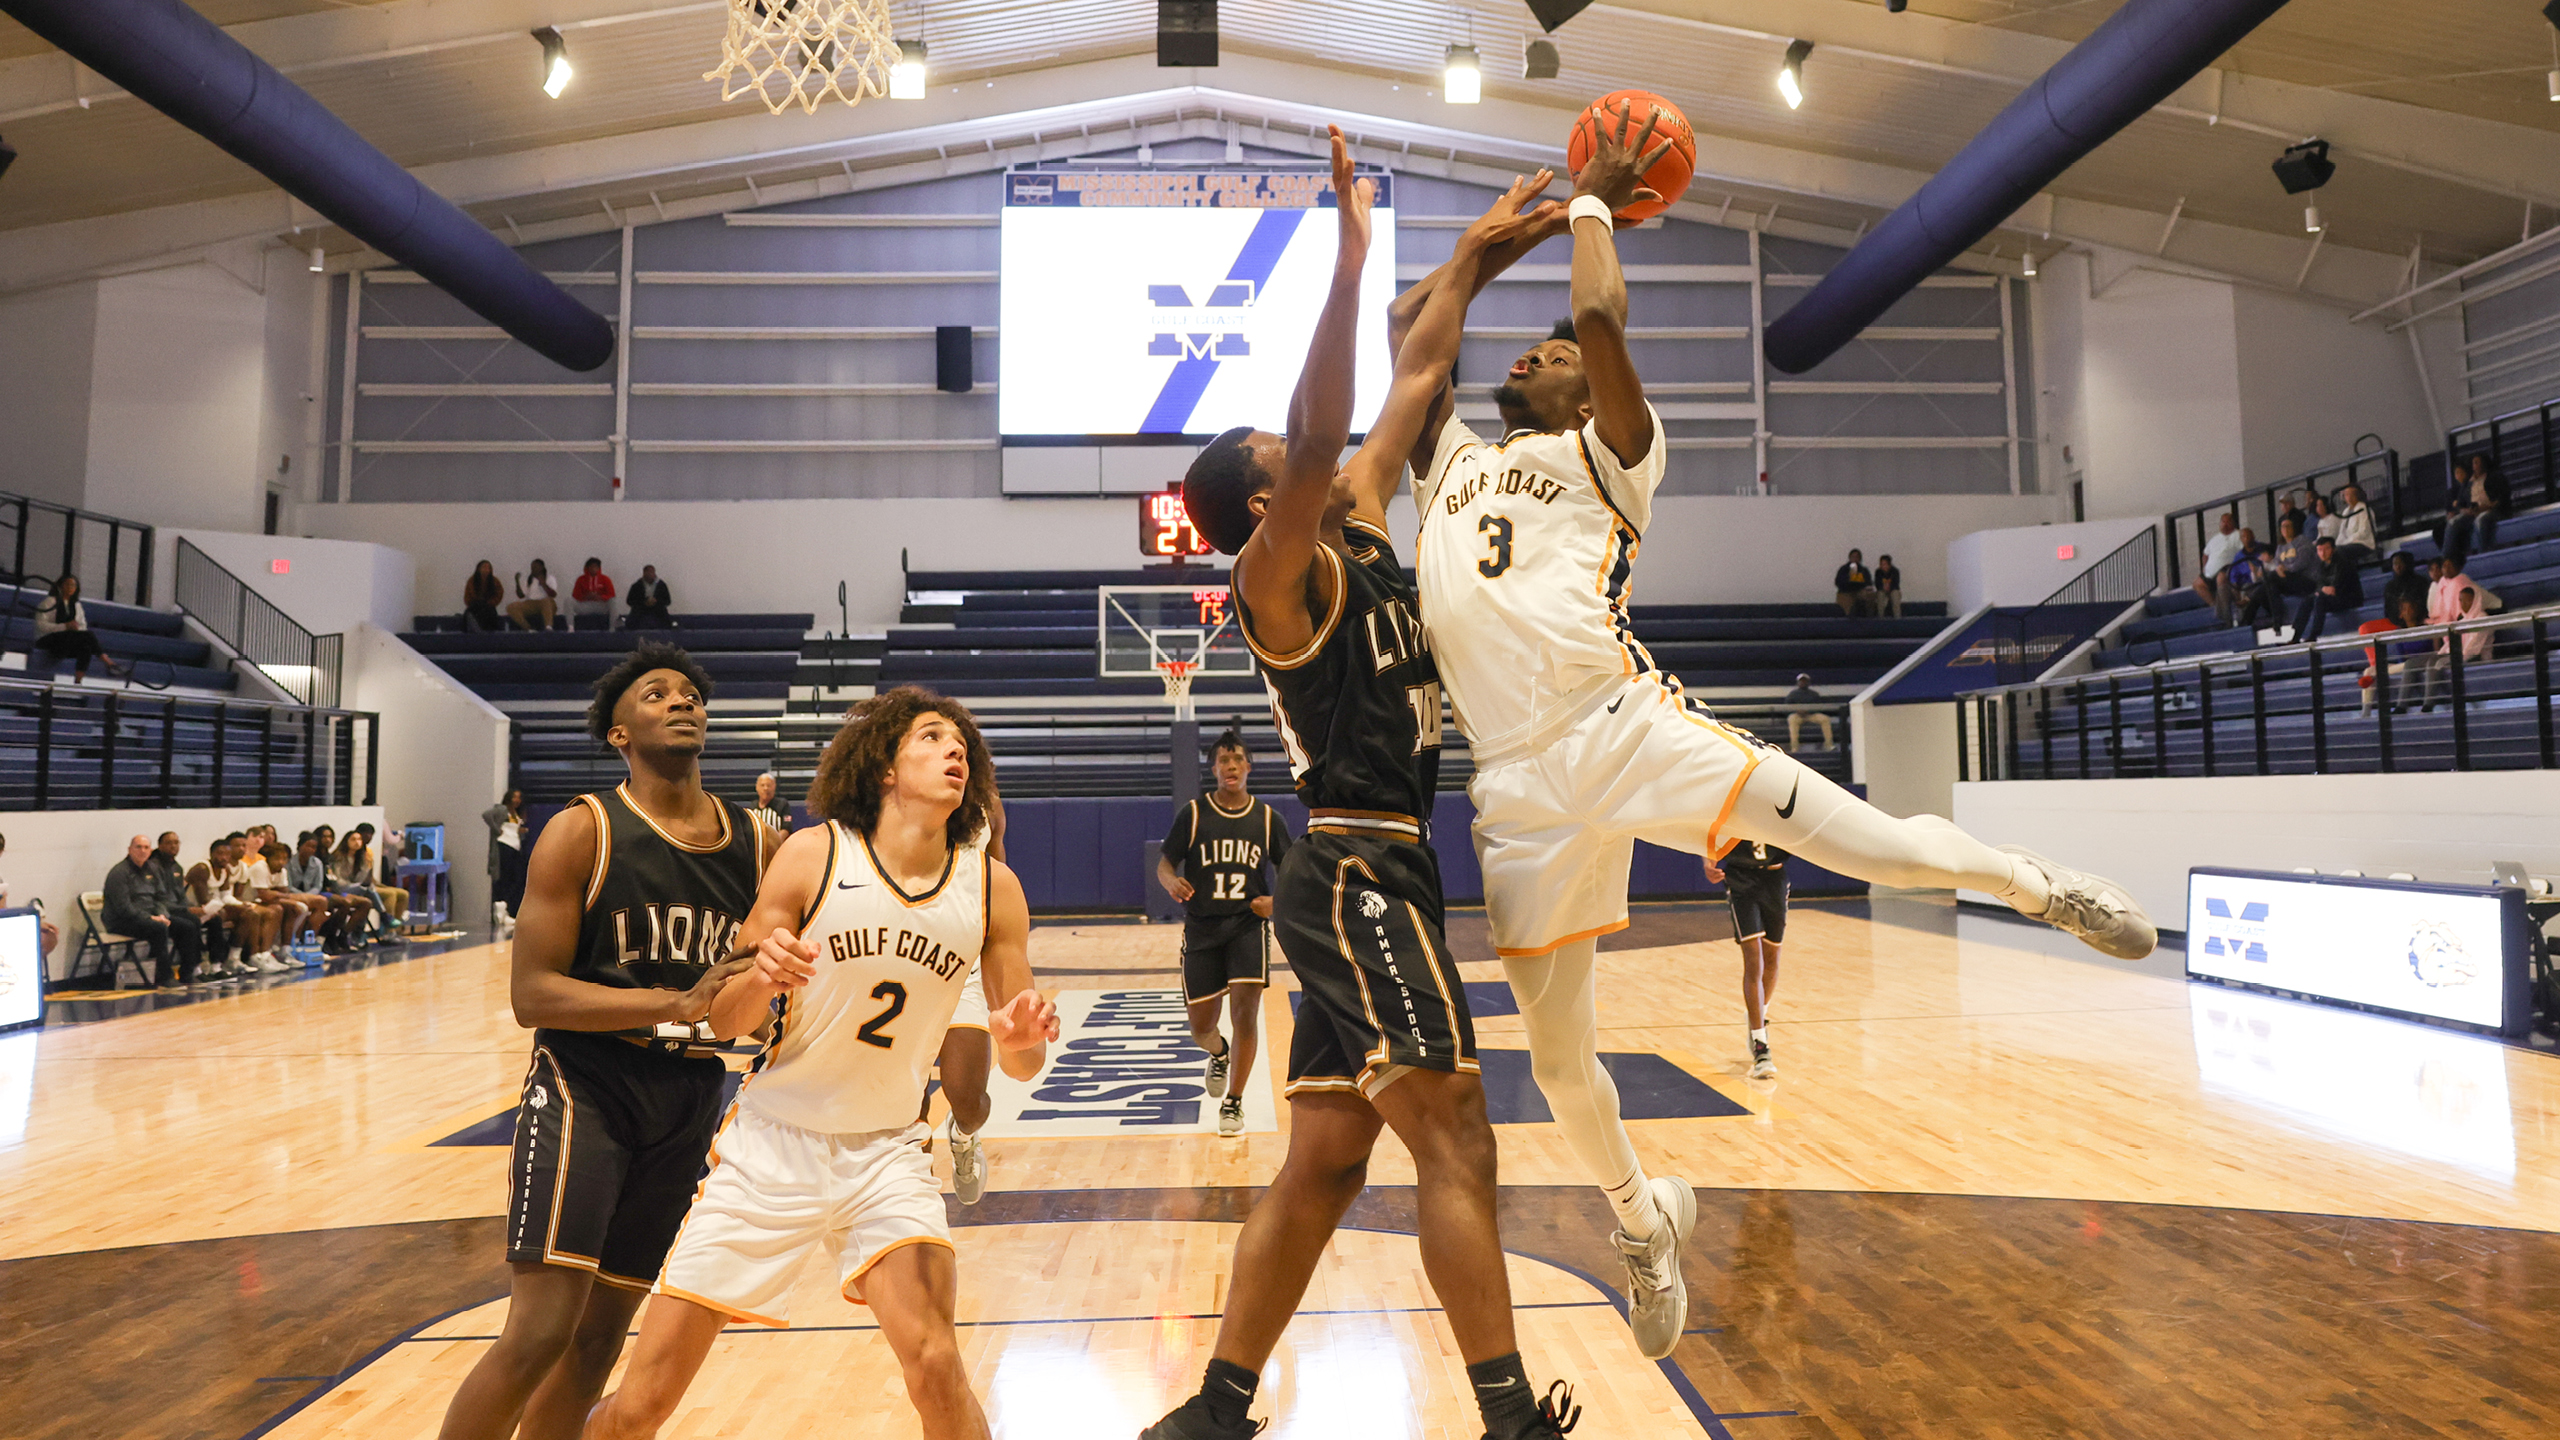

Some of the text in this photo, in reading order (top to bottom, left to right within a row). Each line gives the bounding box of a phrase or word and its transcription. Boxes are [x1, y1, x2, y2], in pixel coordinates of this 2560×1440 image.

[1057, 174, 1198, 191] MISSISSIPPI
[1204, 174, 1262, 191] GULF
[1080, 190, 1319, 207] COMMUNITY COLLEGE
[1151, 315, 1247, 325] GULF COAST
[1446, 472, 1490, 515] GULF
[1157, 519, 1199, 554] 27
[1477, 513, 1514, 580] 3
[1200, 838, 1262, 870] LIONS
[1212, 871, 1247, 900] 12
[828, 927, 966, 982] GULF COAST
[855, 978, 909, 1050] 2
[1017, 1035, 1211, 1125] COAST
[514, 1115, 539, 1250] AMBASSADORS
